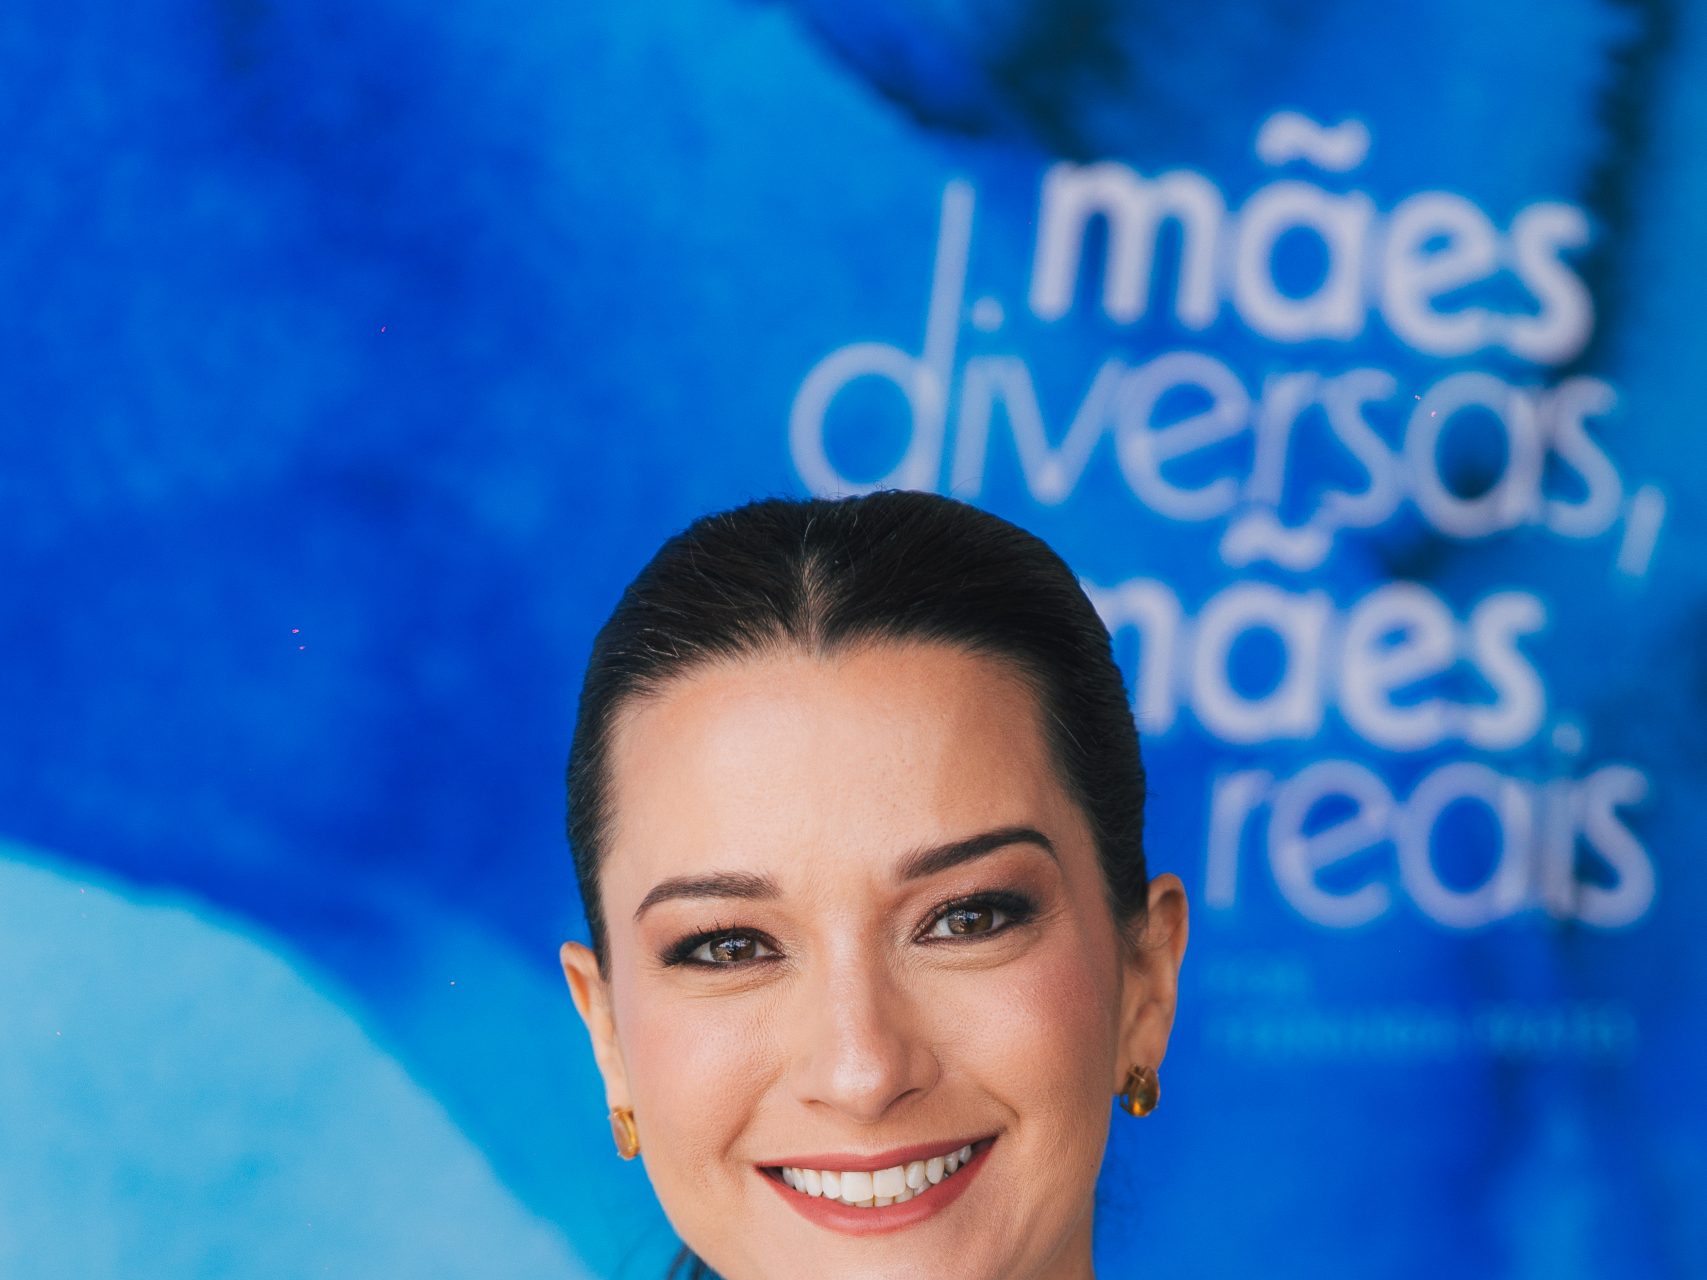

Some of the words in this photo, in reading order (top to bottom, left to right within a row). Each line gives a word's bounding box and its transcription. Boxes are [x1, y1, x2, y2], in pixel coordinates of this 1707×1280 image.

[1029, 110, 1595, 365] mães
[787, 177, 1666, 577] diversas,
[1203, 722, 1656, 928] reais
